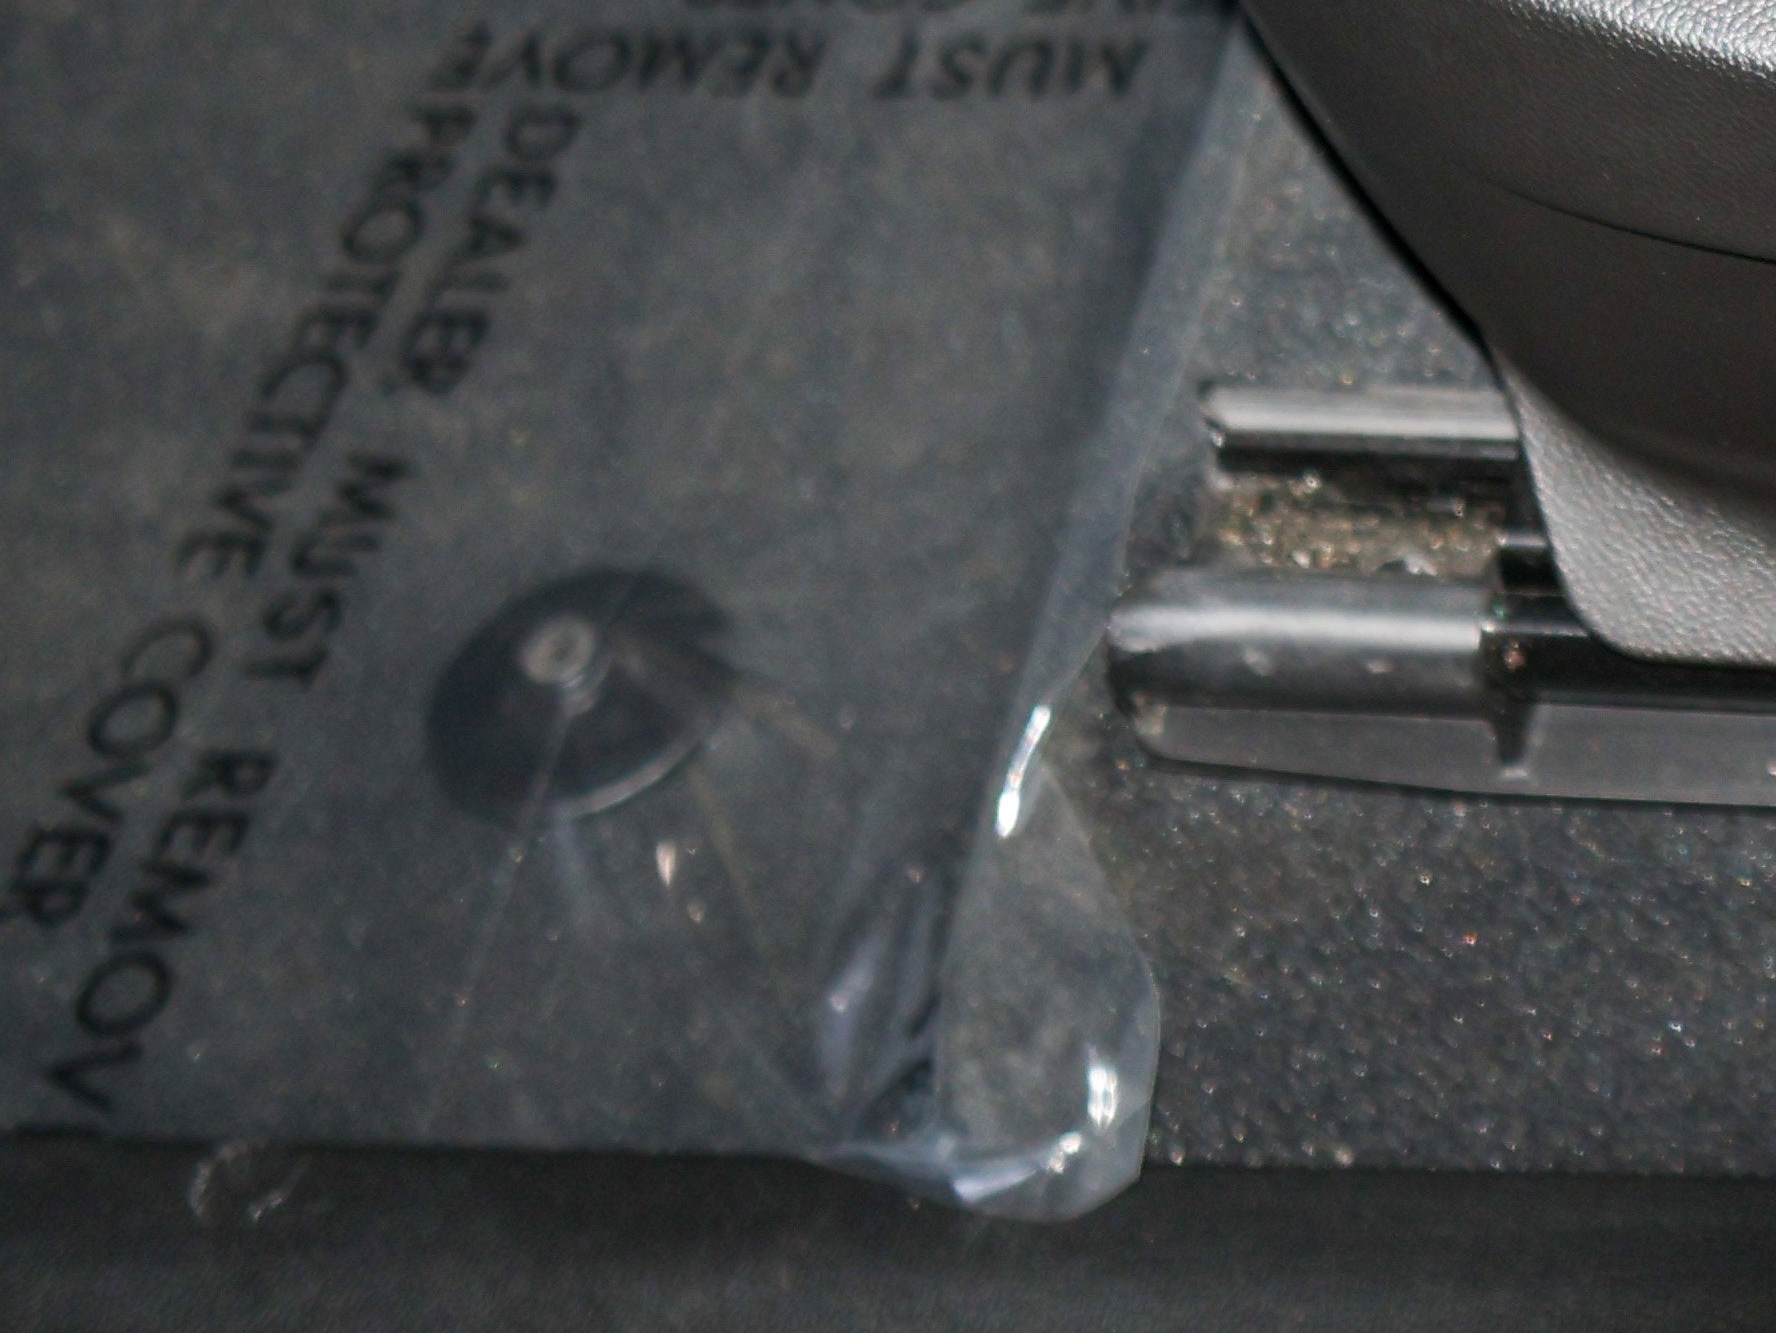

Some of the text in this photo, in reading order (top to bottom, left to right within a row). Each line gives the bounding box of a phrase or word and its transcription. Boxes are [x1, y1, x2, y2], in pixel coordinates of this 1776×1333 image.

[426, 19, 1152, 101] MUST REMOVE
[0, 101, 480, 930] PROTECTIVE COVER
[10, 105, 584, 1145] DEALER MUST REMOV
